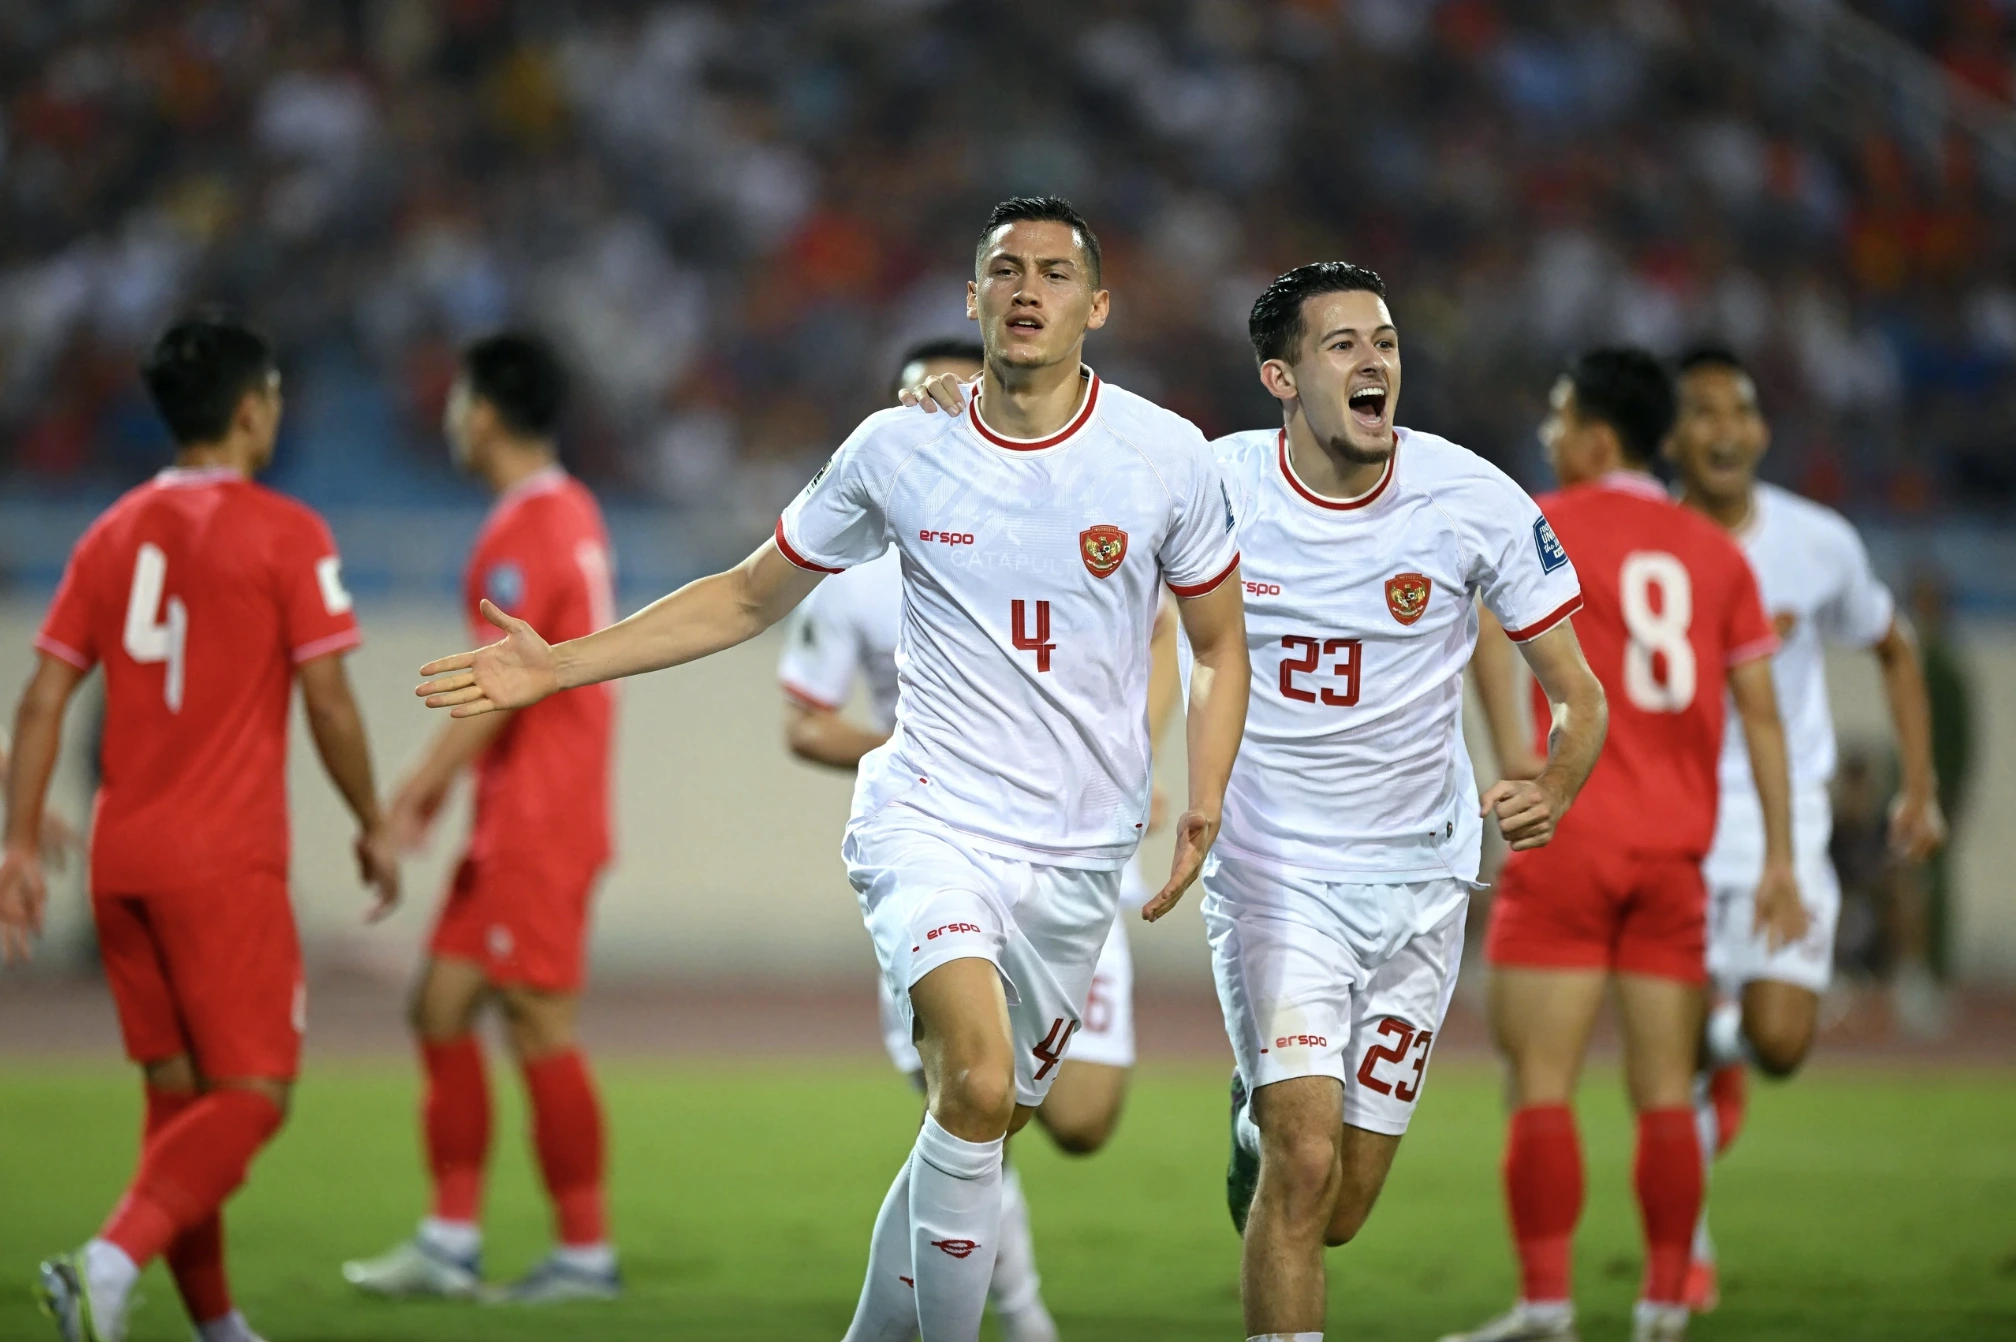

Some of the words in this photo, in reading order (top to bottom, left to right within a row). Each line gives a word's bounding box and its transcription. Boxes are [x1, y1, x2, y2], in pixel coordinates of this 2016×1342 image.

[919, 529, 975, 546] erspo
[1241, 580, 1281, 597] spo
[124, 542, 187, 714] 4
[1011, 599, 1057, 673] 4
[1620, 550, 1697, 714] 8
[1279, 634, 1363, 708] 23
[926, 922, 981, 941] erspo
[1032, 1018, 1068, 1081] 4
[1275, 1034, 1328, 1048] erspo
[1356, 1016, 1433, 1103] 23
